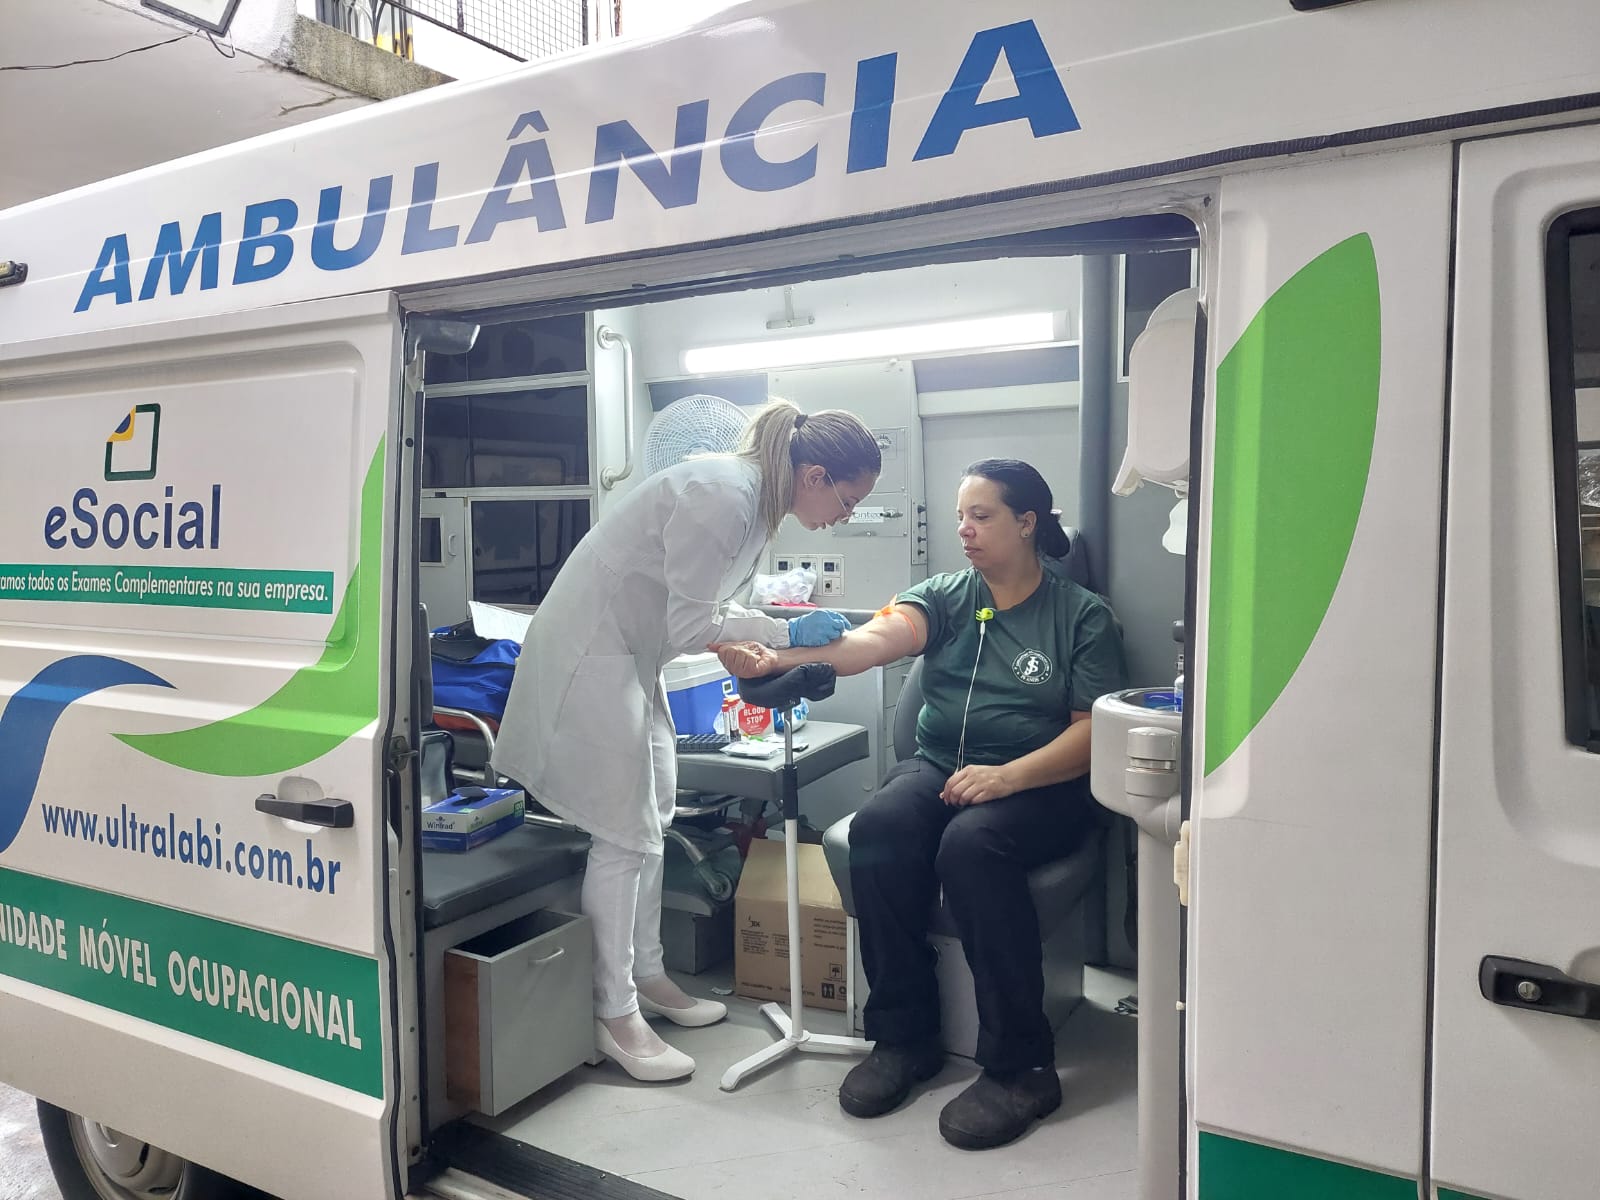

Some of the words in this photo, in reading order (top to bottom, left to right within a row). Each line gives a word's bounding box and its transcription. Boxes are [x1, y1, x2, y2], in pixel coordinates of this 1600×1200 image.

[74, 19, 1081, 313] AMBULÂNCIA
[44, 484, 221, 550] eSocial
[0, 575, 25, 590] amos
[28, 569, 54, 591] todos
[57, 576, 68, 591] os
[72, 570, 111, 592] Exames
[114, 571, 213, 599] Complementares
[217, 581, 233, 597] na
[237, 581, 260, 598] sua
[264, 582, 328, 606] empresa.
[746, 715, 763, 724] STOP
[42, 803, 341, 894] www.ultralabi.com.br
[80, 919, 157, 987] MÓVEL
[168, 951, 361, 1050] OCUPACIONAL
